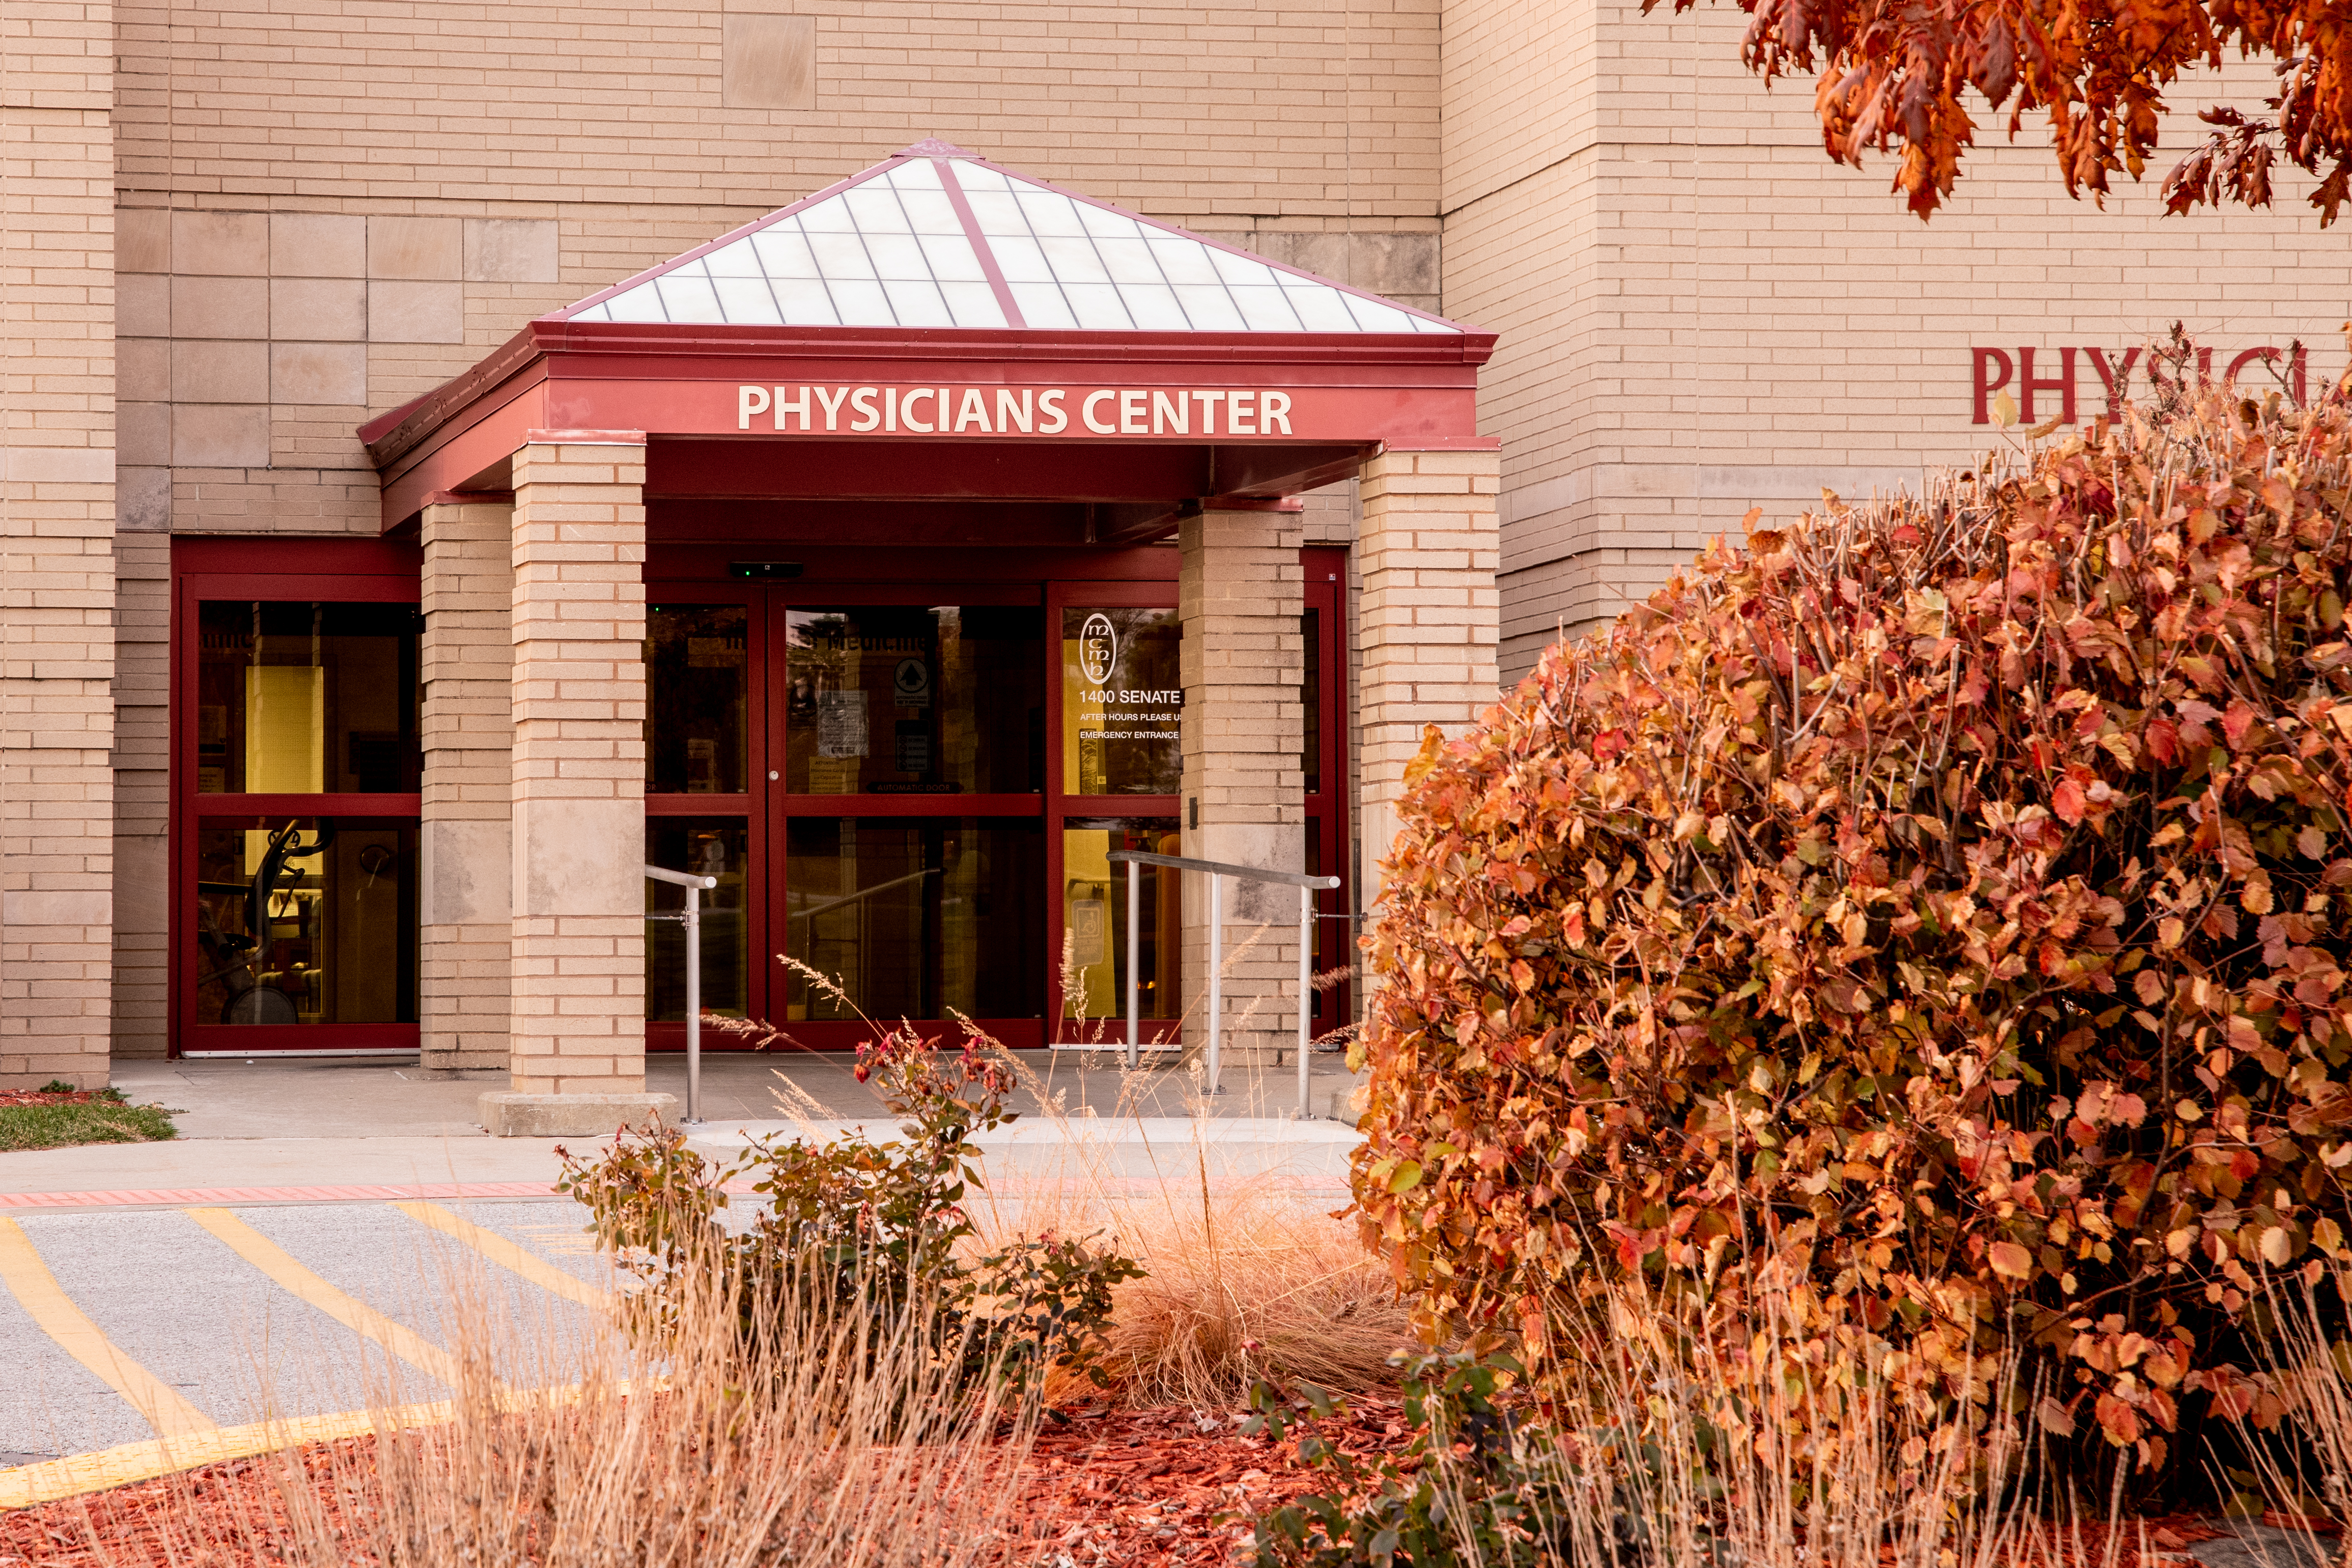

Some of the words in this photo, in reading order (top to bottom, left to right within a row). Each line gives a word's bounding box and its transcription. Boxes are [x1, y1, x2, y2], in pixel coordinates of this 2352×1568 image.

[738, 385, 1069, 434] PHYSICIANS
[1082, 390, 1293, 436] CENTER
[1972, 347, 2352, 425] PHYSICI
[1079, 690, 1115, 703] 1400
[1119, 690, 1180, 704] SENATE
